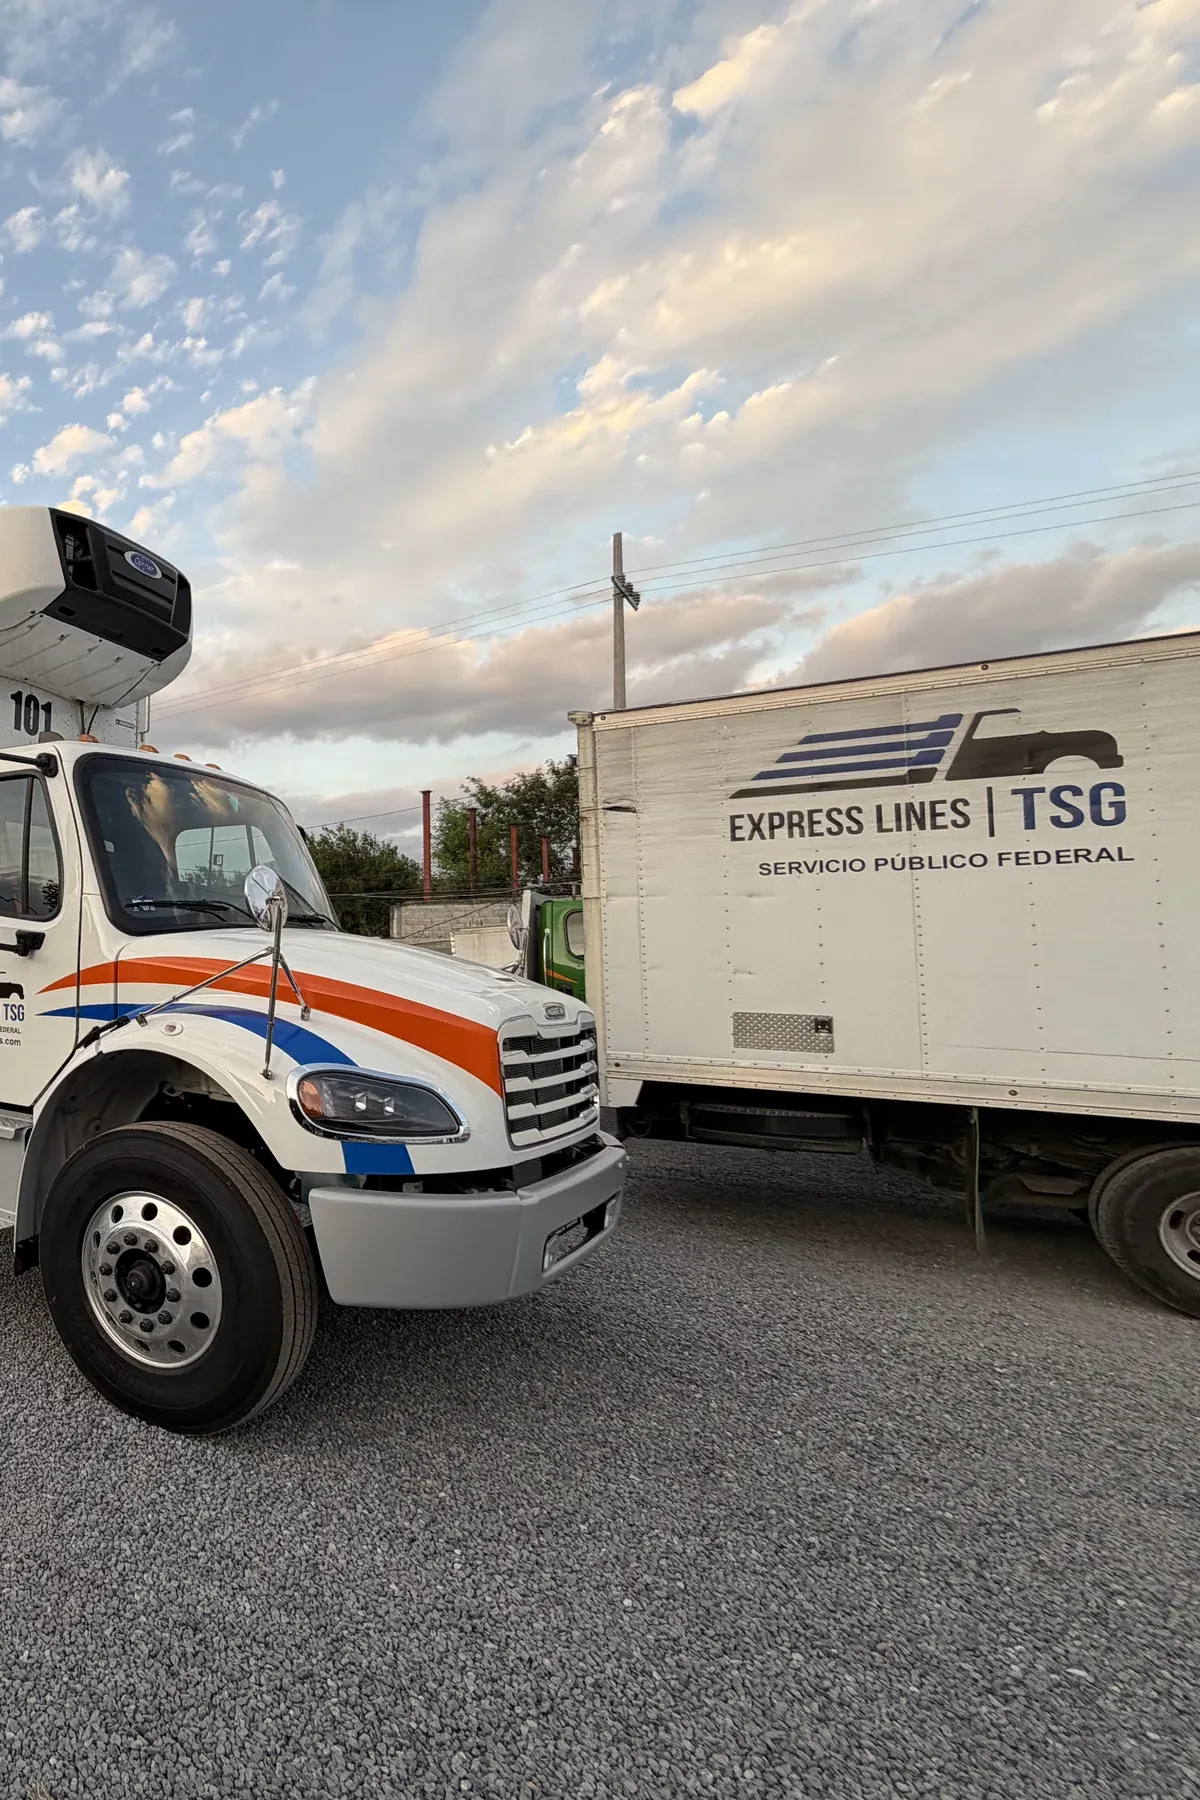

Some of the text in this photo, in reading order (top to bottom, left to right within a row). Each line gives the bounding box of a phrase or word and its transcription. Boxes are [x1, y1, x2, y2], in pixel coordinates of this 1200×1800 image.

[10, 690, 53, 736] 101
[729, 781, 1128, 842] EXPRESS LINES TSG
[758, 846, 1135, 877] SERVICIO PÚBLICO FEDERAL
[3, 1003, 25, 1022] TSG
